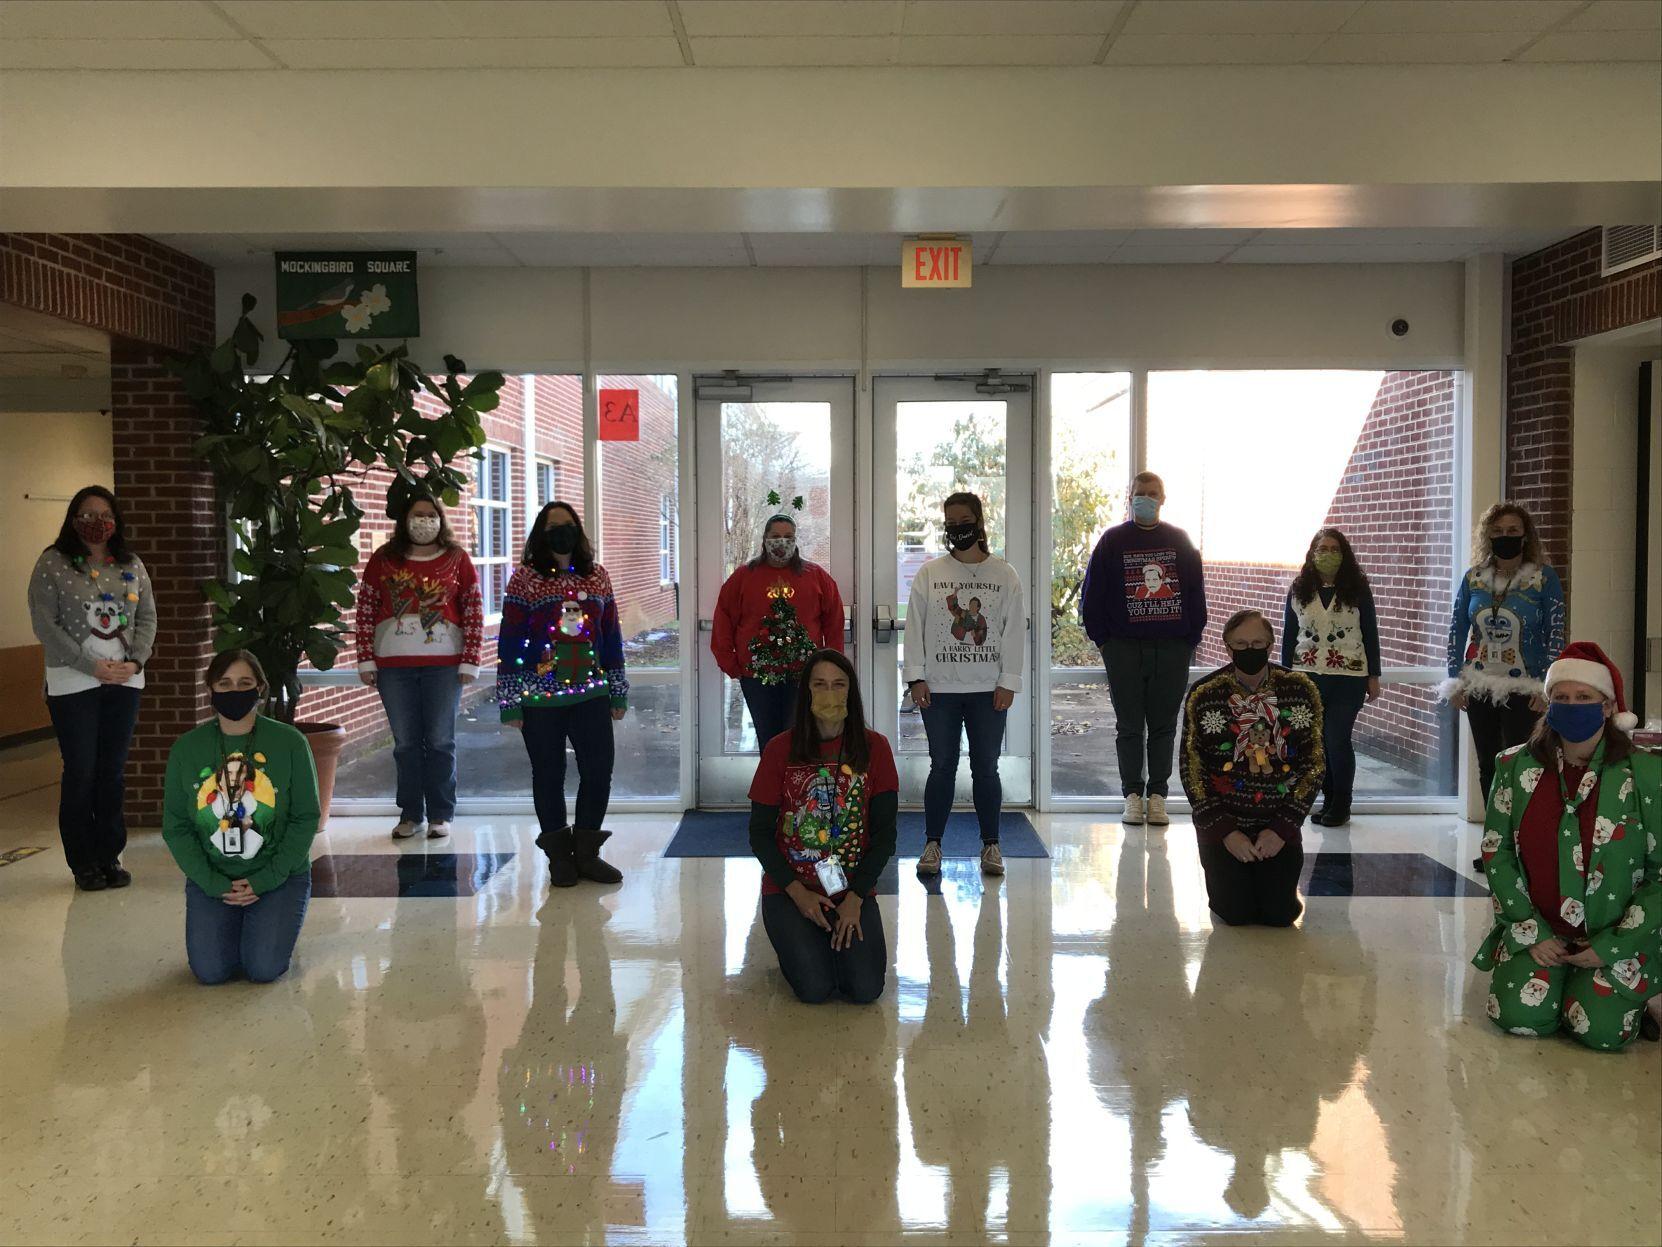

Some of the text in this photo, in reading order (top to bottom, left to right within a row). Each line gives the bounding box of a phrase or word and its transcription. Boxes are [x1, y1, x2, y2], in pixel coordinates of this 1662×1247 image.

[281, 261, 411, 273] MOCKINGBIRD SQUARE
[915, 247, 962, 280] EXIT
[934, 582, 1001, 592] HAVE YOURSELF
[1144, 600, 1160, 608] I'LL
[1160, 599, 1182, 607] HELP
[1128, 608, 1146, 616] YOU
[1147, 607, 1169, 615] FIND
[974, 645, 996, 653] LITTLE
